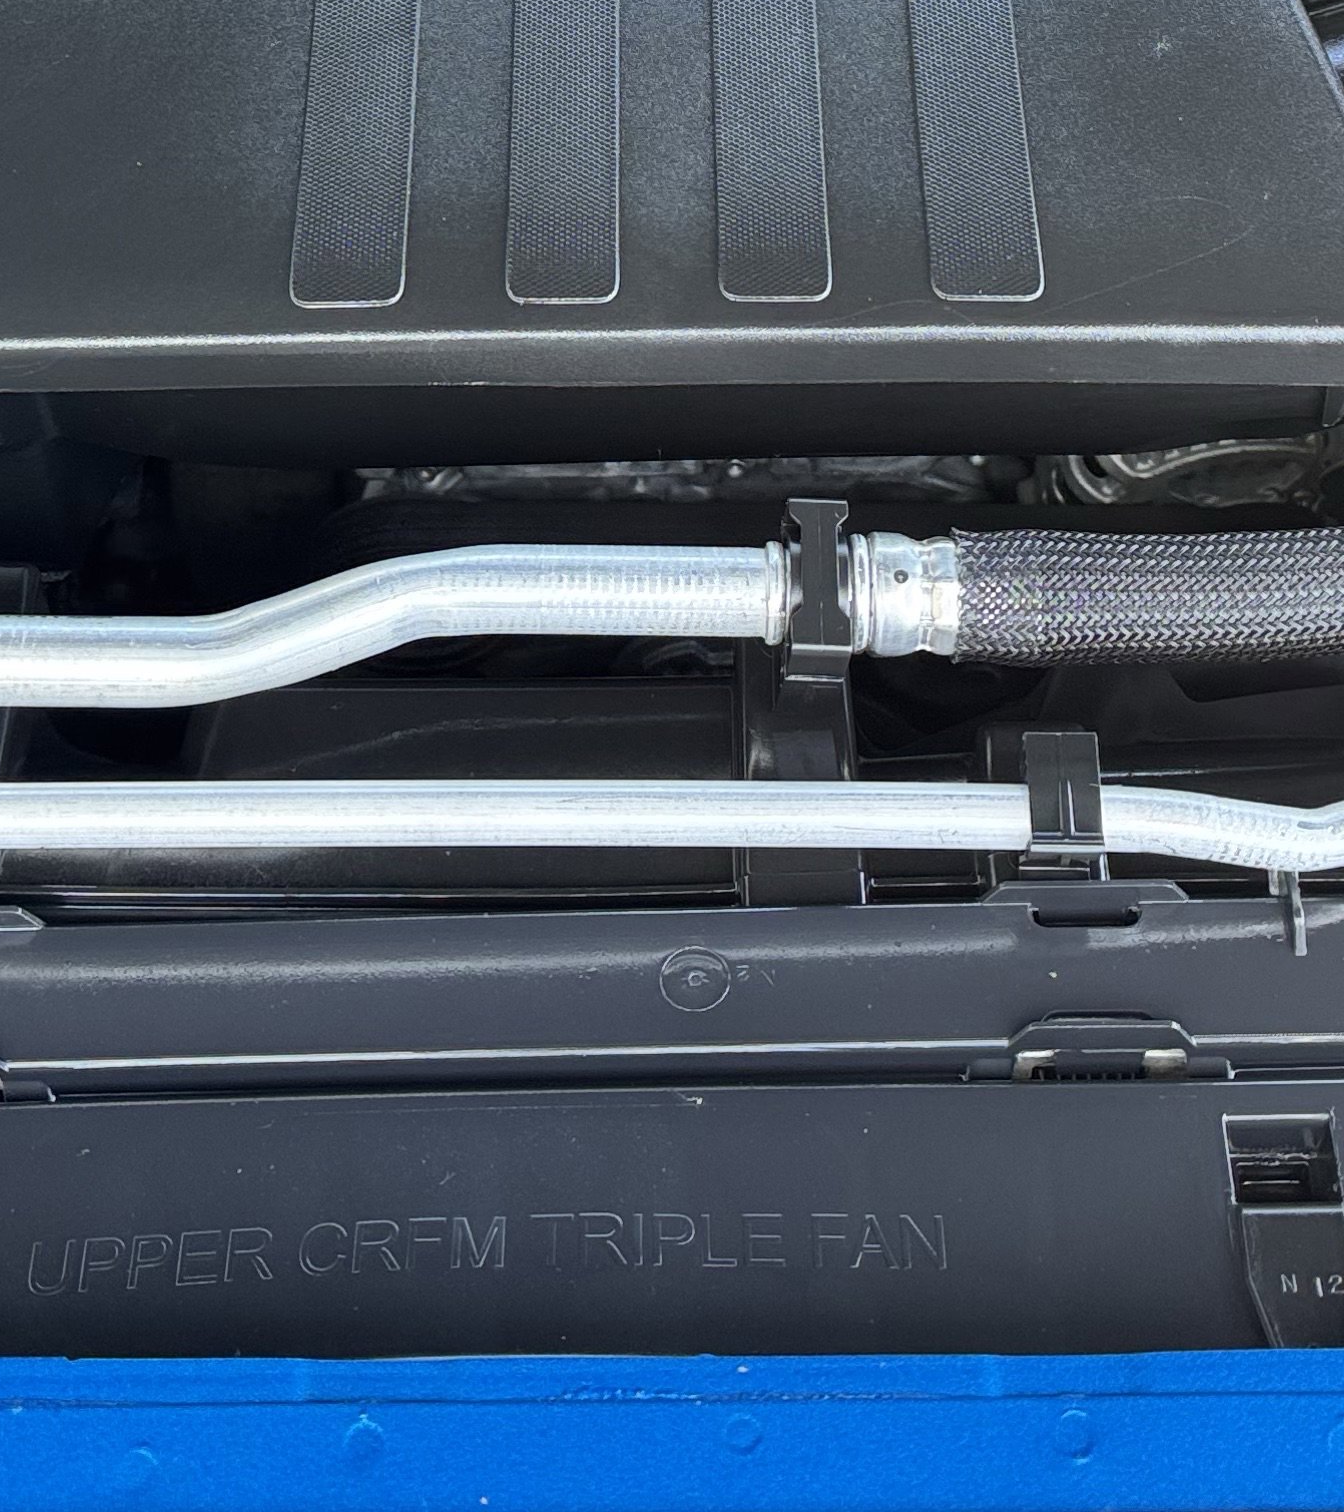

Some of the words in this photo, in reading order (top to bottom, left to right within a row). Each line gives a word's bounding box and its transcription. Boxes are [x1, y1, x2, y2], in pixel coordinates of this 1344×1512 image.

[27, 1226, 274, 1297] UPPER
[298, 1215, 507, 1277] CRFM
[529, 1211, 787, 1270] TRIPLE
[809, 1212, 948, 1271] FAN
